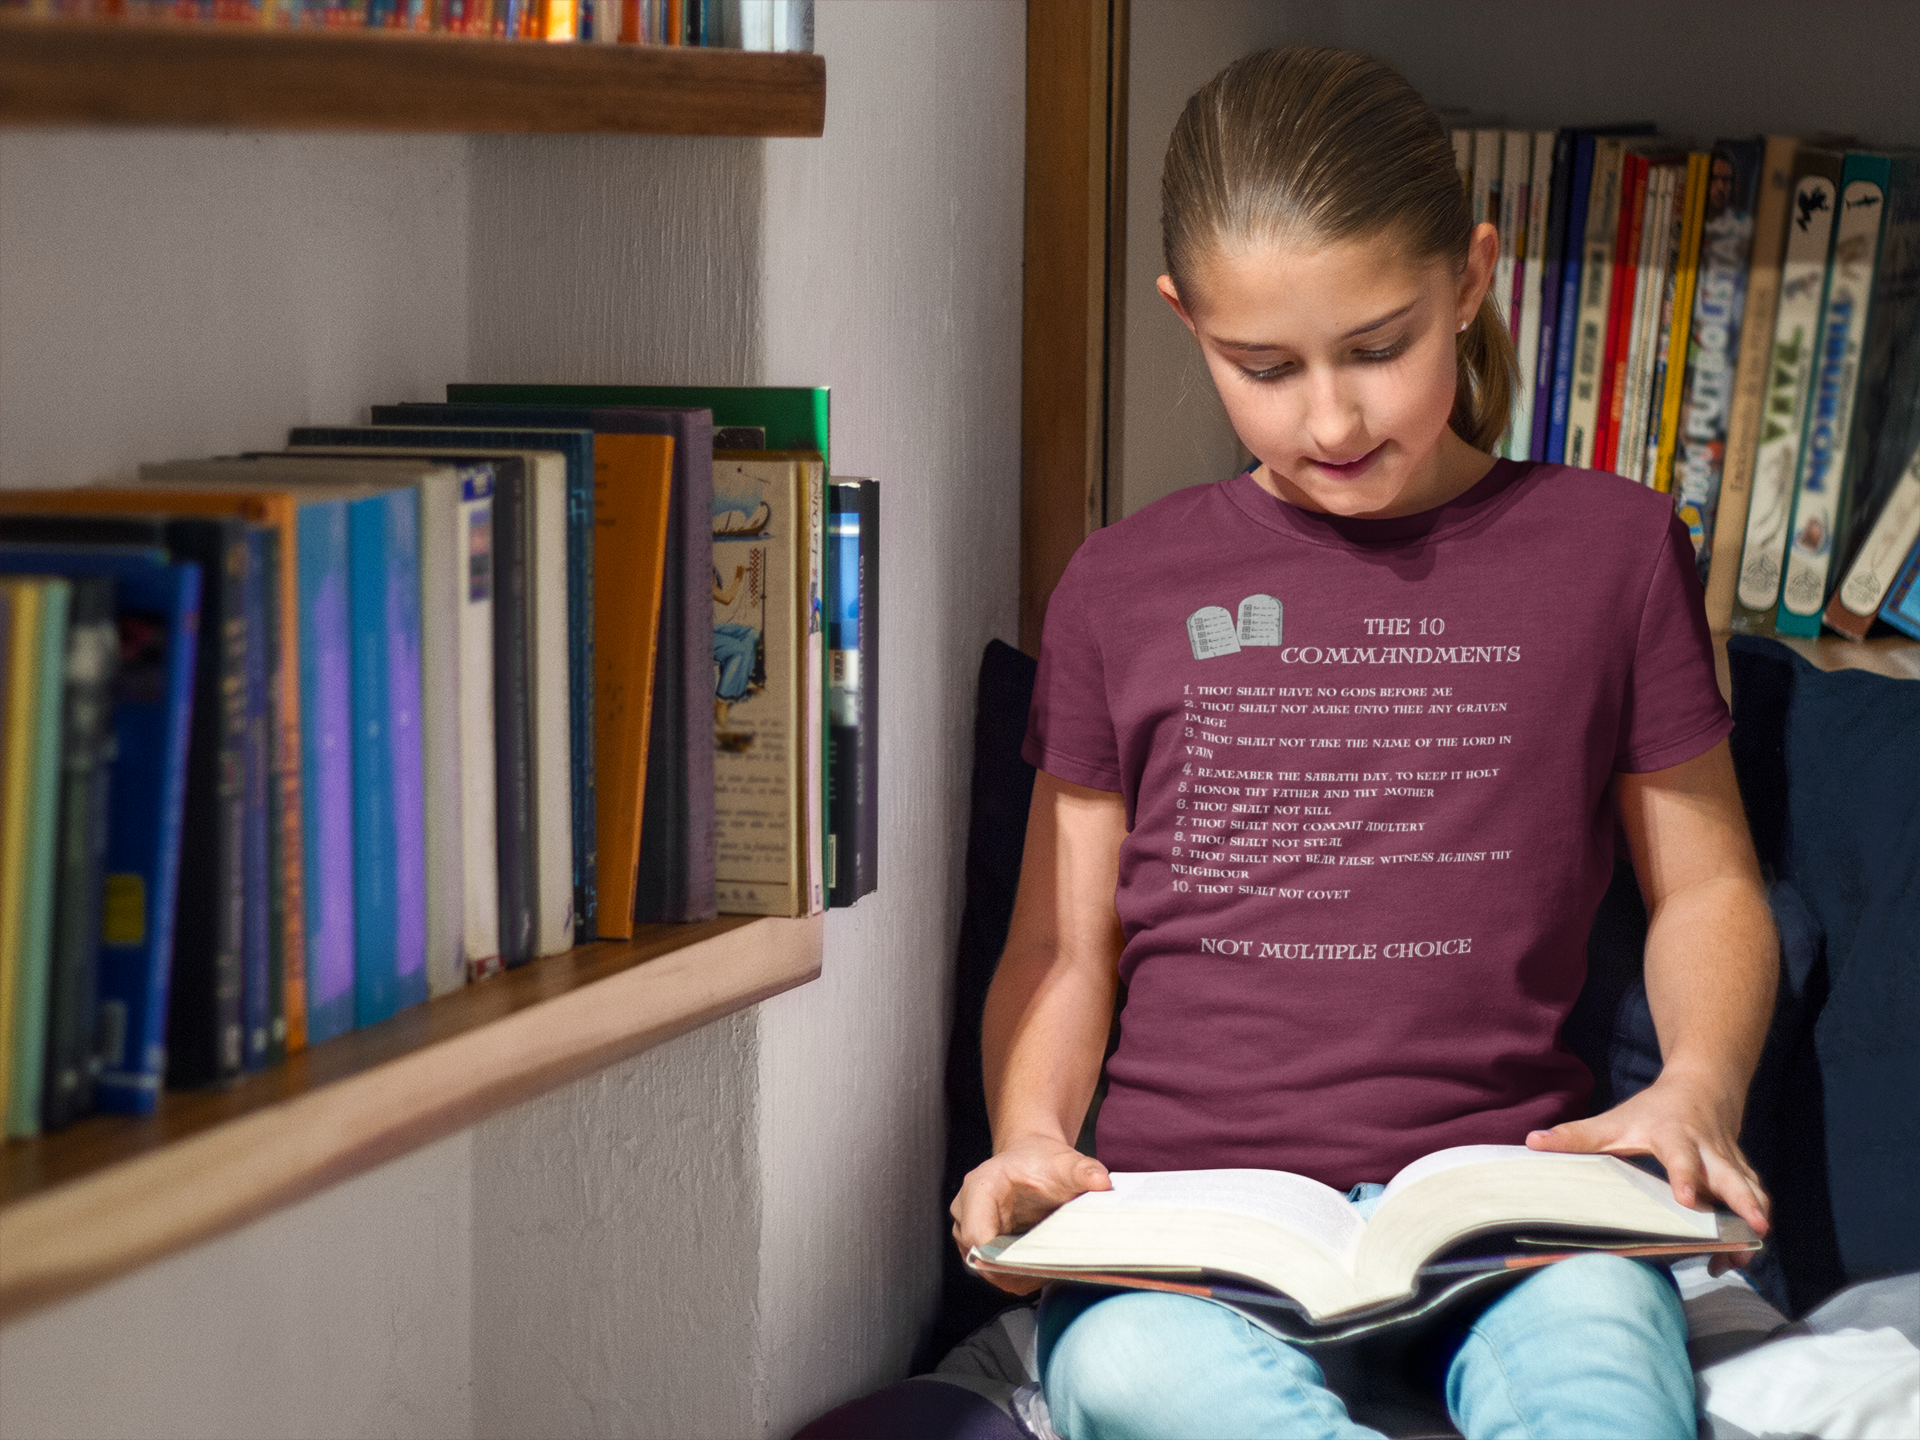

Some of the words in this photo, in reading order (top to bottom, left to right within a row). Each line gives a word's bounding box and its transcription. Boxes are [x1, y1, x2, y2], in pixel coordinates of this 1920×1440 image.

[1363, 617, 1410, 635] THE
[1418, 617, 1445, 635] 10
[1280, 646, 1520, 664] COMMANDMENTS
[1197, 685, 1232, 695] THOU
[1236, 686, 1275, 696] SHALT
[1278, 687, 1312, 696] HAVE
[1317, 687, 1337, 696] NO
[1340, 687, 1376, 697] GODS
[1379, 687, 1427, 697] BEFORE
[1431, 687, 1452, 696] ME
[1200, 701, 1234, 711] THOU
[1238, 703, 1277, 713] SHALT
[1280, 704, 1308, 713] NOT
[1311, 704, 1349, 714] MAKE
[1353, 704, 1389, 714] UNTO
[1392, 704, 1423, 714] THEE
[1427, 704, 1453, 713] ANY
[1456, 702, 1507, 712] GRAVEN
[1185, 712, 1226, 728] IMAGE
[1200, 730, 1232, 744] THOU
[1236, 736, 1275, 746] SHALT
[1278, 737, 1305, 747] NOT
[1309, 738, 1341, 747] TAKE
[1345, 738, 1368, 748] THE
[1372, 738, 1410, 747] NAME
[1414, 737, 1432, 747] OF
[1435, 737, 1458, 746] THE
[1462, 736, 1495, 746] LORD
[1498, 735, 1511, 744] IN
[1185, 745, 1213, 759] VAIN
[1197, 767, 1273, 780] REMEMBER
[1277, 771, 1300, 781] THE
[1304, 772, 1358, 781] SABBATH
[1395, 771, 1413, 780] TO
[1416, 771, 1447, 780] KEEP
[1450, 770, 1462, 779] IT
[1465, 767, 1499, 779] HOLY
[1194, 784, 1240, 795] HONOR
[1244, 787, 1268, 796] THY
[1272, 788, 1318, 798] FATHER
[1323, 789, 1349, 798] AND
[1353, 788, 1378, 798] THY
[1383, 787, 1434, 797] MOTHER
[1193, 801, 1227, 811] THOU
[1231, 803, 1269, 813] SHALT
[1274, 805, 1300, 815] NOT
[1304, 806, 1331, 815] KILL
[1191, 817, 1226, 828] THOU
[1230, 820, 1268, 830] SHALT
[1271, 821, 1298, 831] NOT
[1302, 820, 1363, 831] COMMIT
[1365, 821, 1425, 832] ADULTERY
[1189, 833, 1226, 843] THOU
[1229, 836, 1268, 846] SHALT
[1272, 838, 1299, 847] NOT
[1303, 837, 1341, 847] STEAL
[1188, 849, 1225, 861] THOU
[1228, 853, 1268, 863] SHALT
[1272, 854, 1301, 863] NOT
[1305, 853, 1335, 864] BEAR
[1338, 855, 1374, 866] FALSE
[1379, 852, 1434, 864] WITNESS
[1436, 851, 1487, 862] AGAINST
[1489, 849, 1512, 860] THY
[1171, 863, 1249, 878] NEIGHBOUR
[1195, 883, 1233, 893] THOU
[1238, 885, 1276, 896] SHALT
[1277, 887, 1304, 899] NOT
[1306, 889, 1350, 899] COVET
[1201, 937, 1253, 955] NOT
[1258, 941, 1377, 960] MULTIPLE
[1382, 937, 1472, 958] CHOICE
